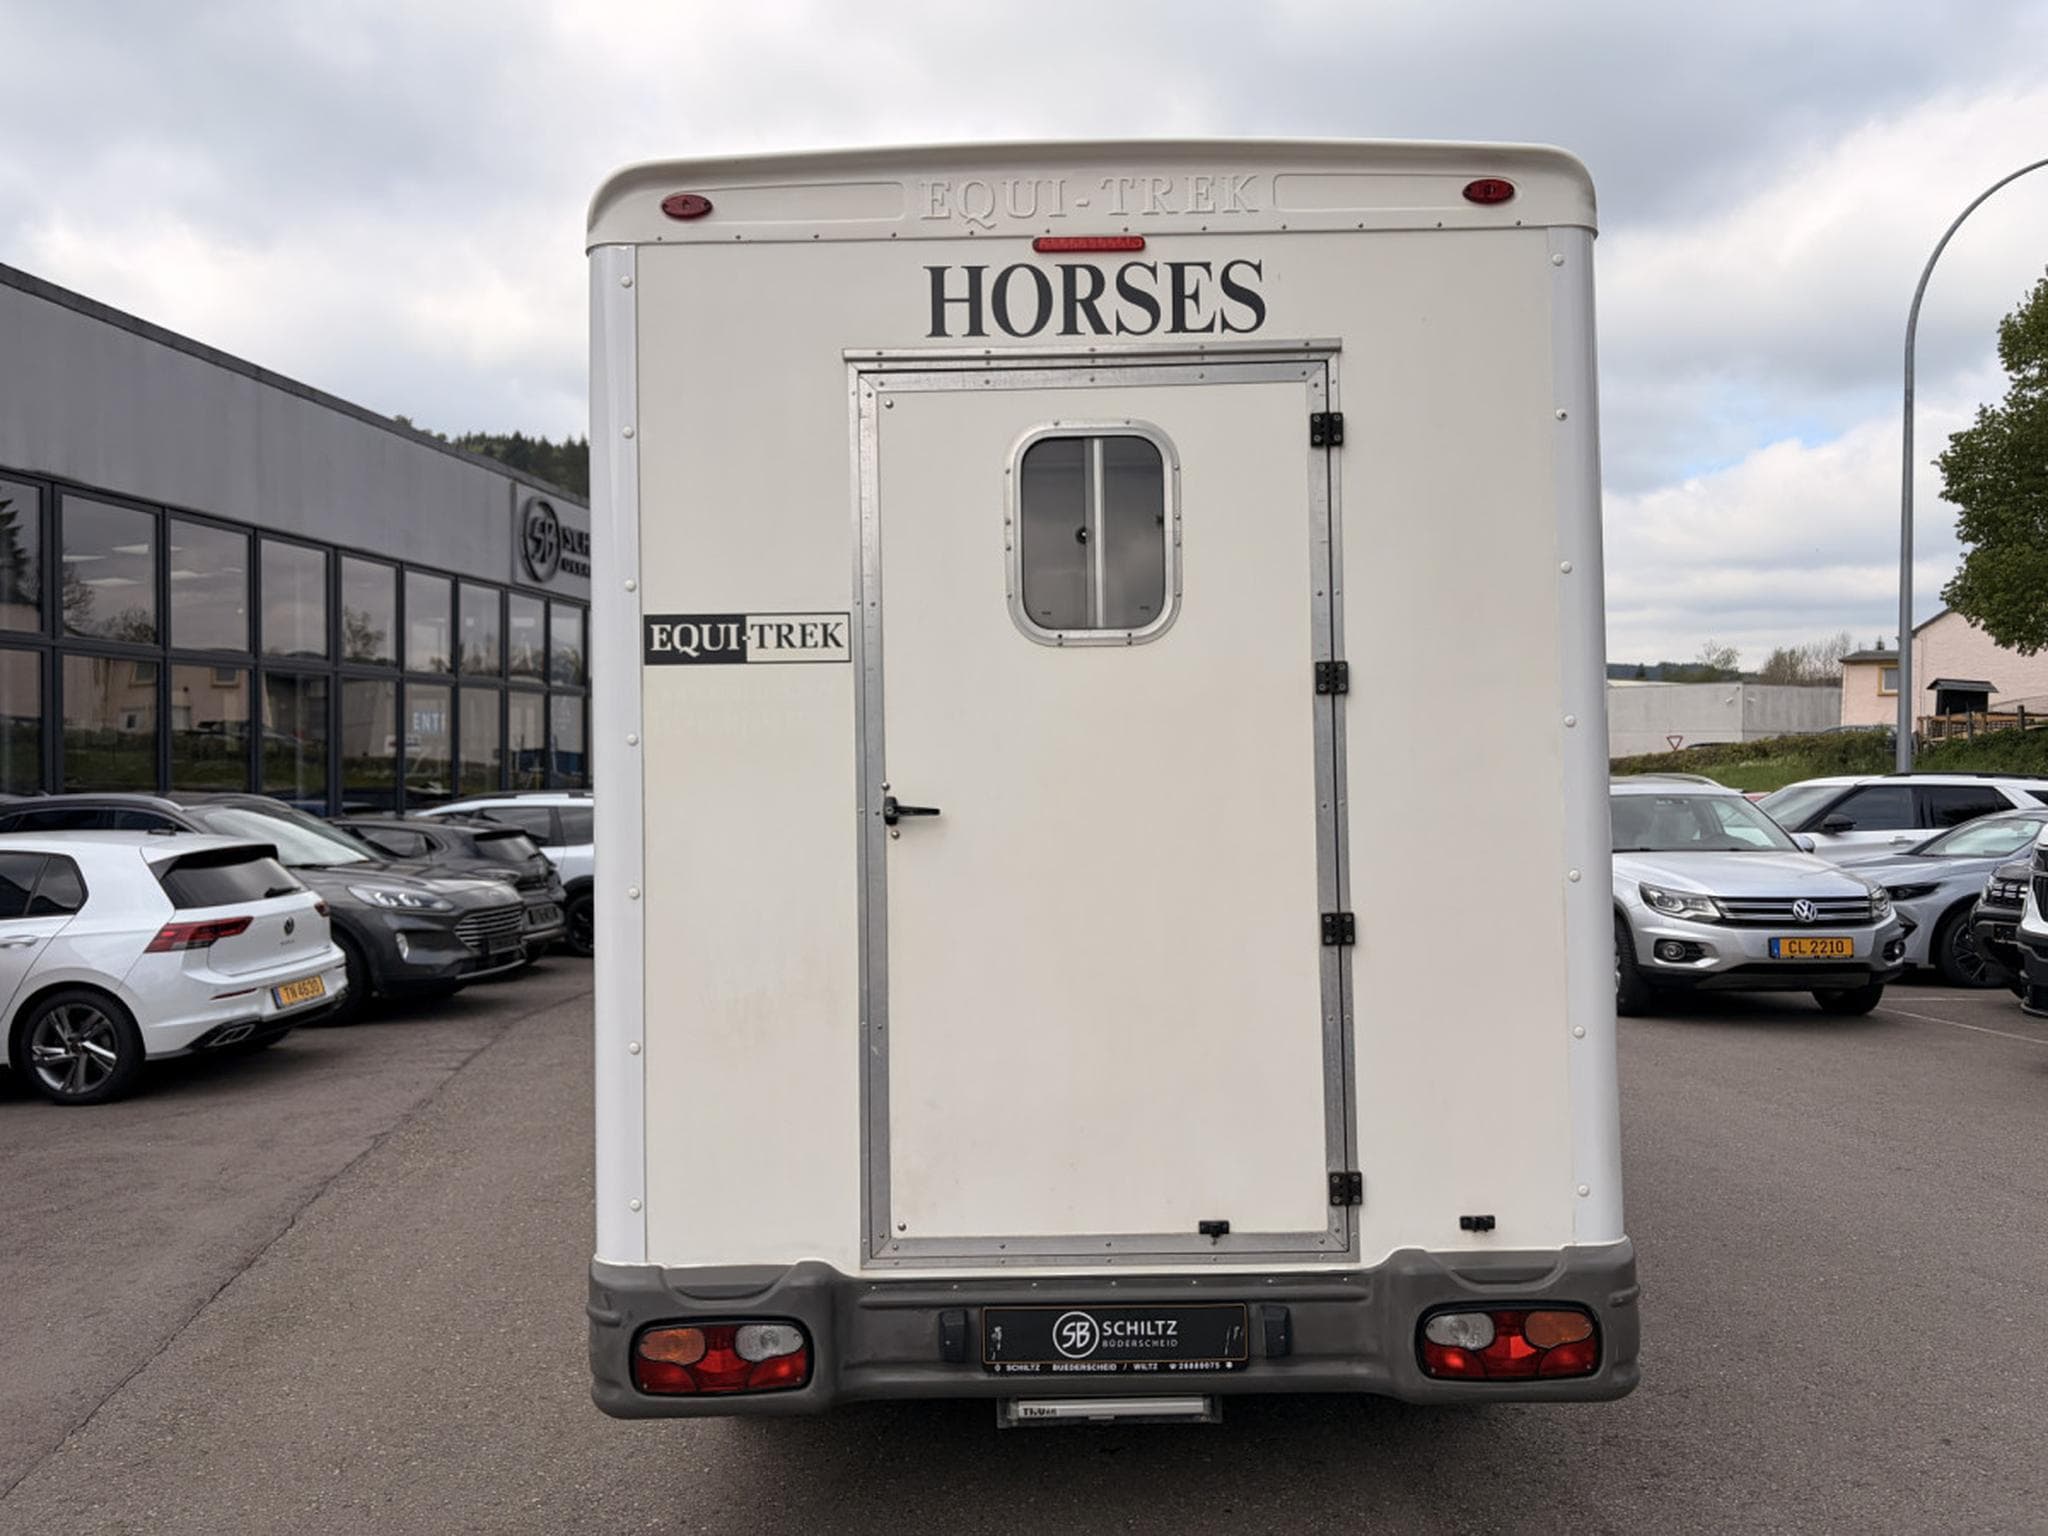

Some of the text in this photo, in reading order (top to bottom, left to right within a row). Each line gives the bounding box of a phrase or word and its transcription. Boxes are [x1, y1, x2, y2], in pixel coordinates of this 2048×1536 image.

[923, 259, 1266, 338] HORSES
[1810, 940, 1844, 954] 2210
[1102, 1320, 1178, 1336] SCHILTZ
